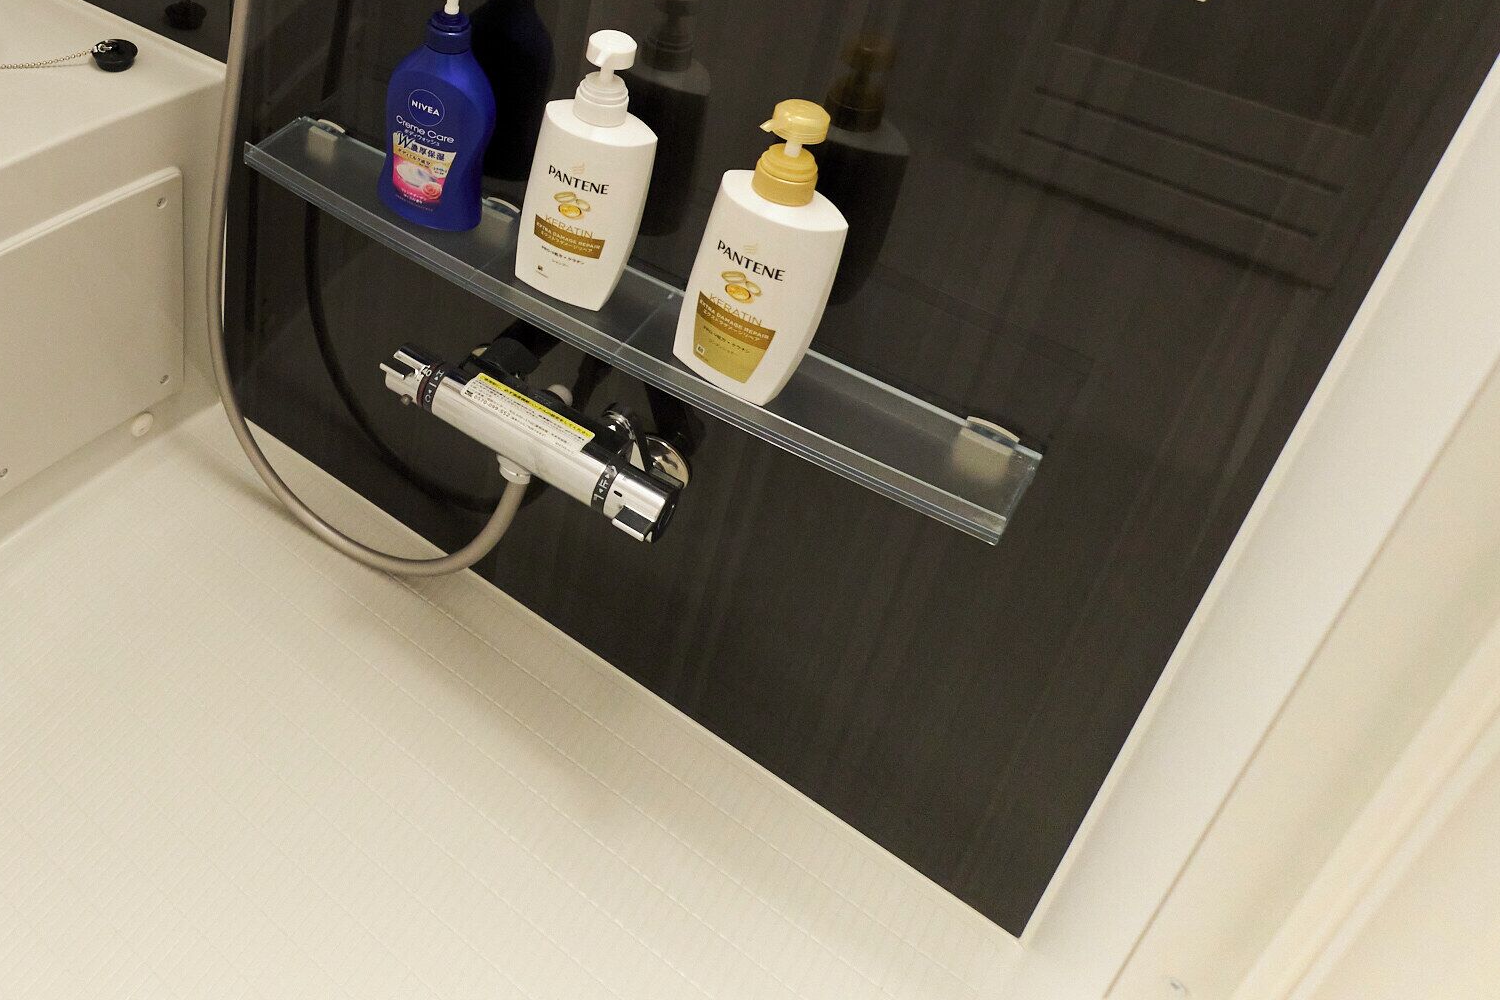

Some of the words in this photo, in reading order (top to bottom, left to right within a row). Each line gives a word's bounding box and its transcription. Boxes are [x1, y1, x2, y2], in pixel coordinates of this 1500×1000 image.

[411, 99, 440, 117] NIVEA
[404, 129, 440, 146] ボディウォッシュ
[428, 131, 454, 144] Care
[548, 164, 610, 195] PANTENE
[536, 222, 552, 234] EXTRA
[552, 232, 577, 244] DAMAGE
[578, 242, 601, 250] REPAIR
[546, 215, 594, 238] KERATIN
[717, 240, 786, 282] PANTENE
[699, 299, 716, 315] EXTRA
[716, 312, 743, 330] DAMAGE
[744, 327, 770, 340] REPAIR
[710, 293, 762, 327] KERATIN
